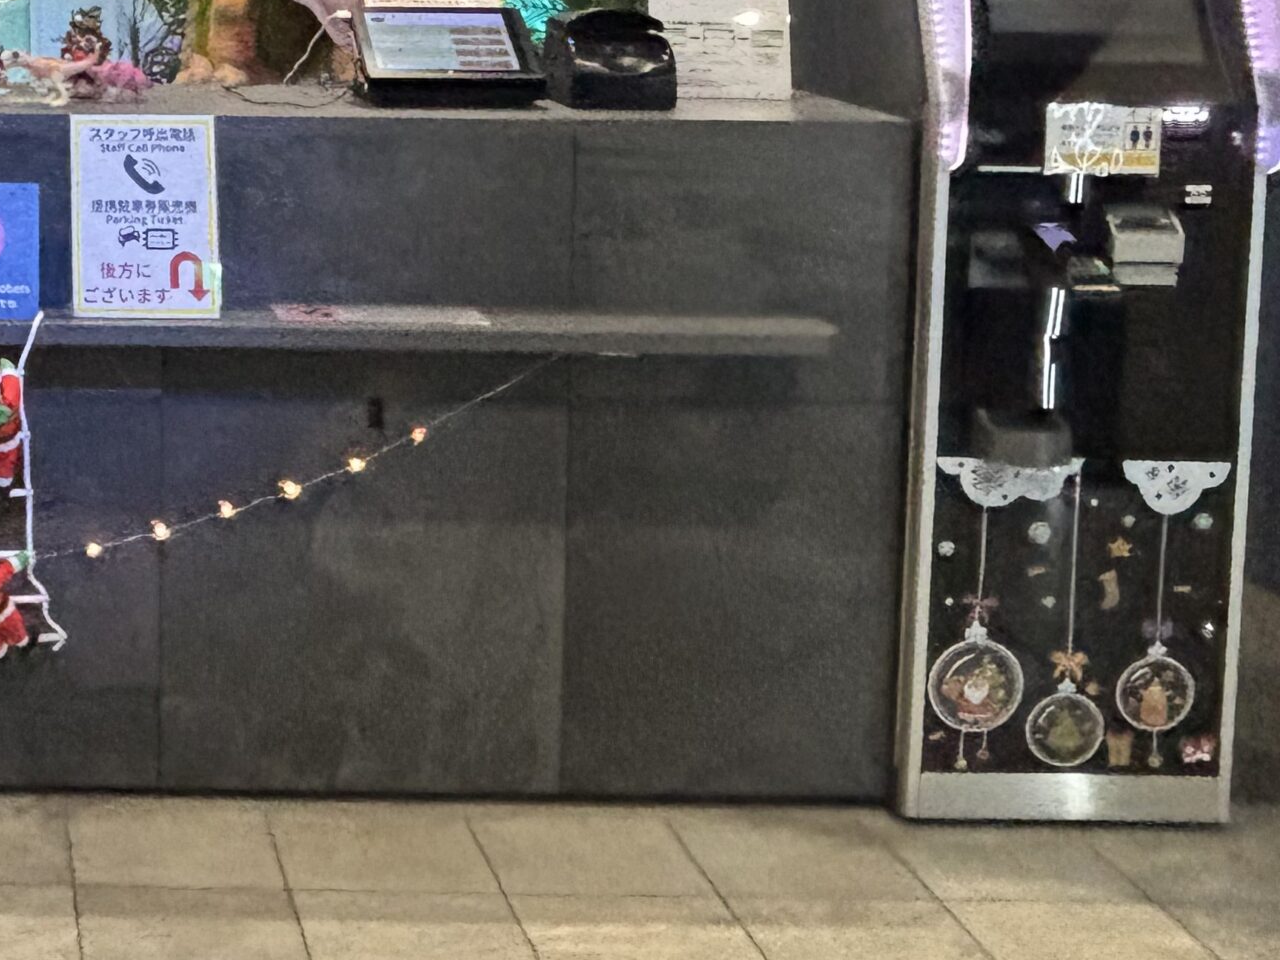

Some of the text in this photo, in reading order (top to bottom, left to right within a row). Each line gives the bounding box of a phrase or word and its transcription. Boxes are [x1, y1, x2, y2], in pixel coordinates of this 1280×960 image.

[151, 143, 185, 153] Phone
[106, 215, 148, 226] Parking
[101, 262, 151, 279] 後方に
[84, 287, 173, 304] ございます
